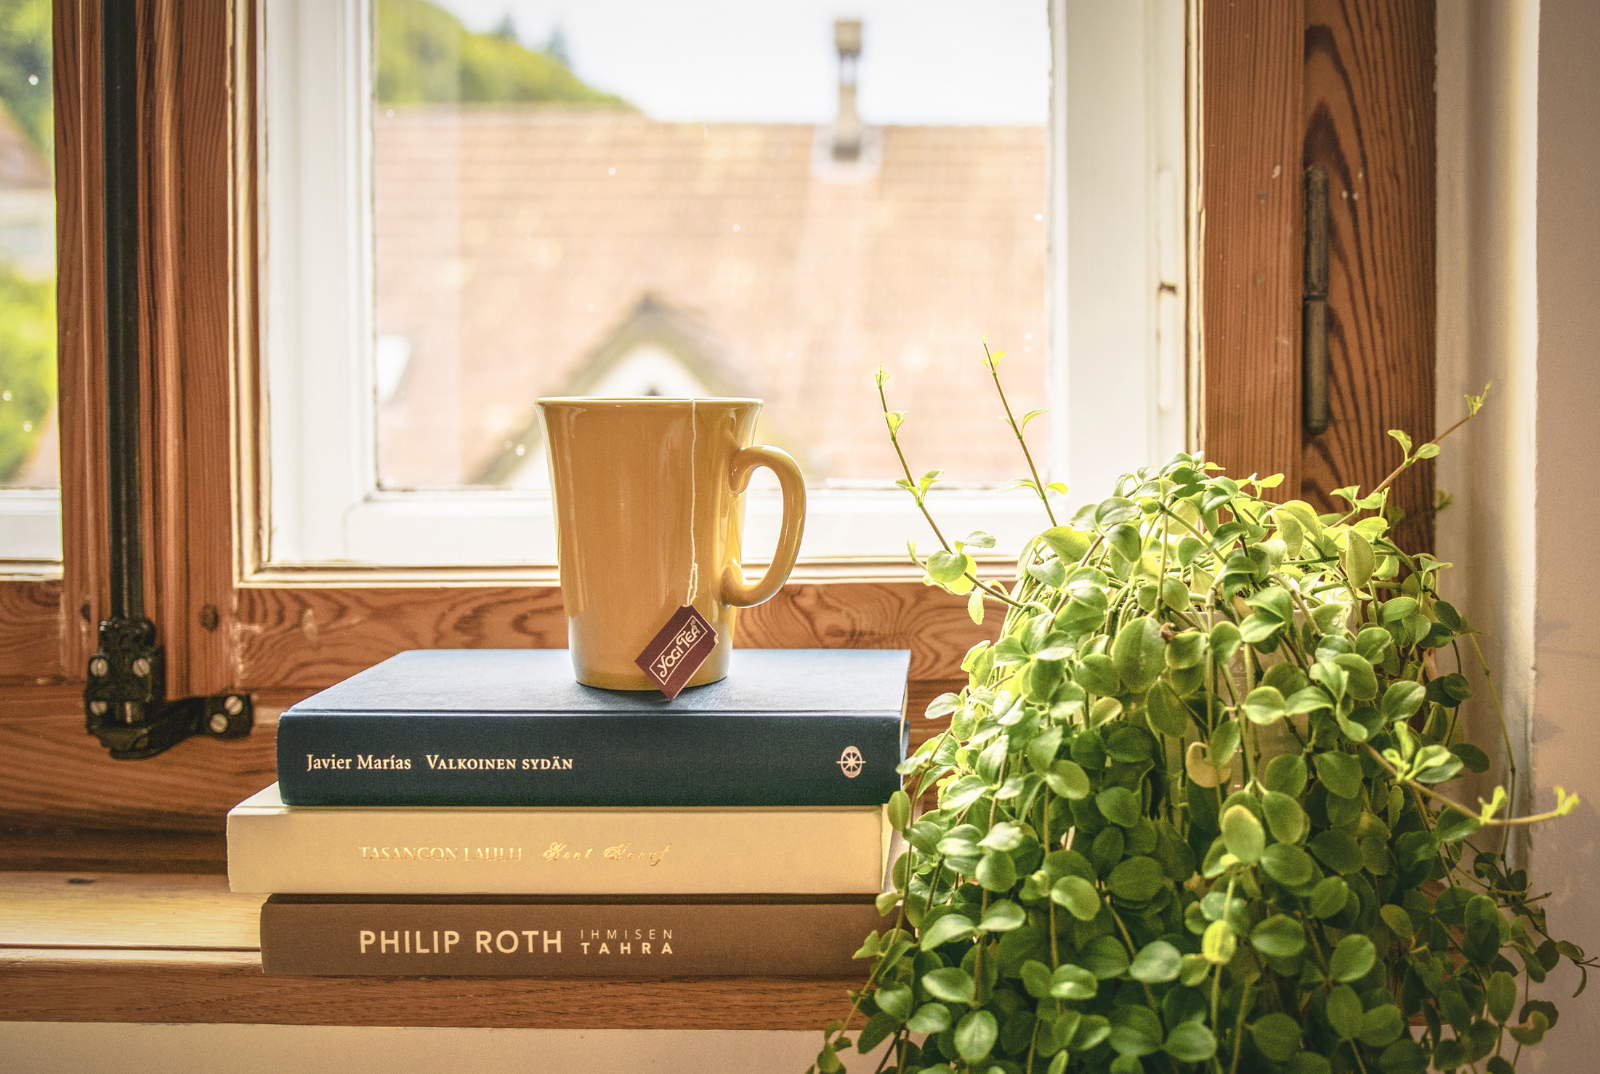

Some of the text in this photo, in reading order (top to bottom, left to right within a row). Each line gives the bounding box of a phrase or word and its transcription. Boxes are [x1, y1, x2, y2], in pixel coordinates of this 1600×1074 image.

[656, 625, 701, 678] YOGI TEA
[306, 754, 412, 772] Javier Marías
[425, 754, 517, 770] VALKOINEN
[358, 846, 522, 862] TASANGON LAULU
[542, 841, 593, 861] Kent
[359, 930, 562, 953] PHILIP ROTH
[580, 929, 673, 940] IHMISEN
[580, 942, 673, 955] TAHRA
